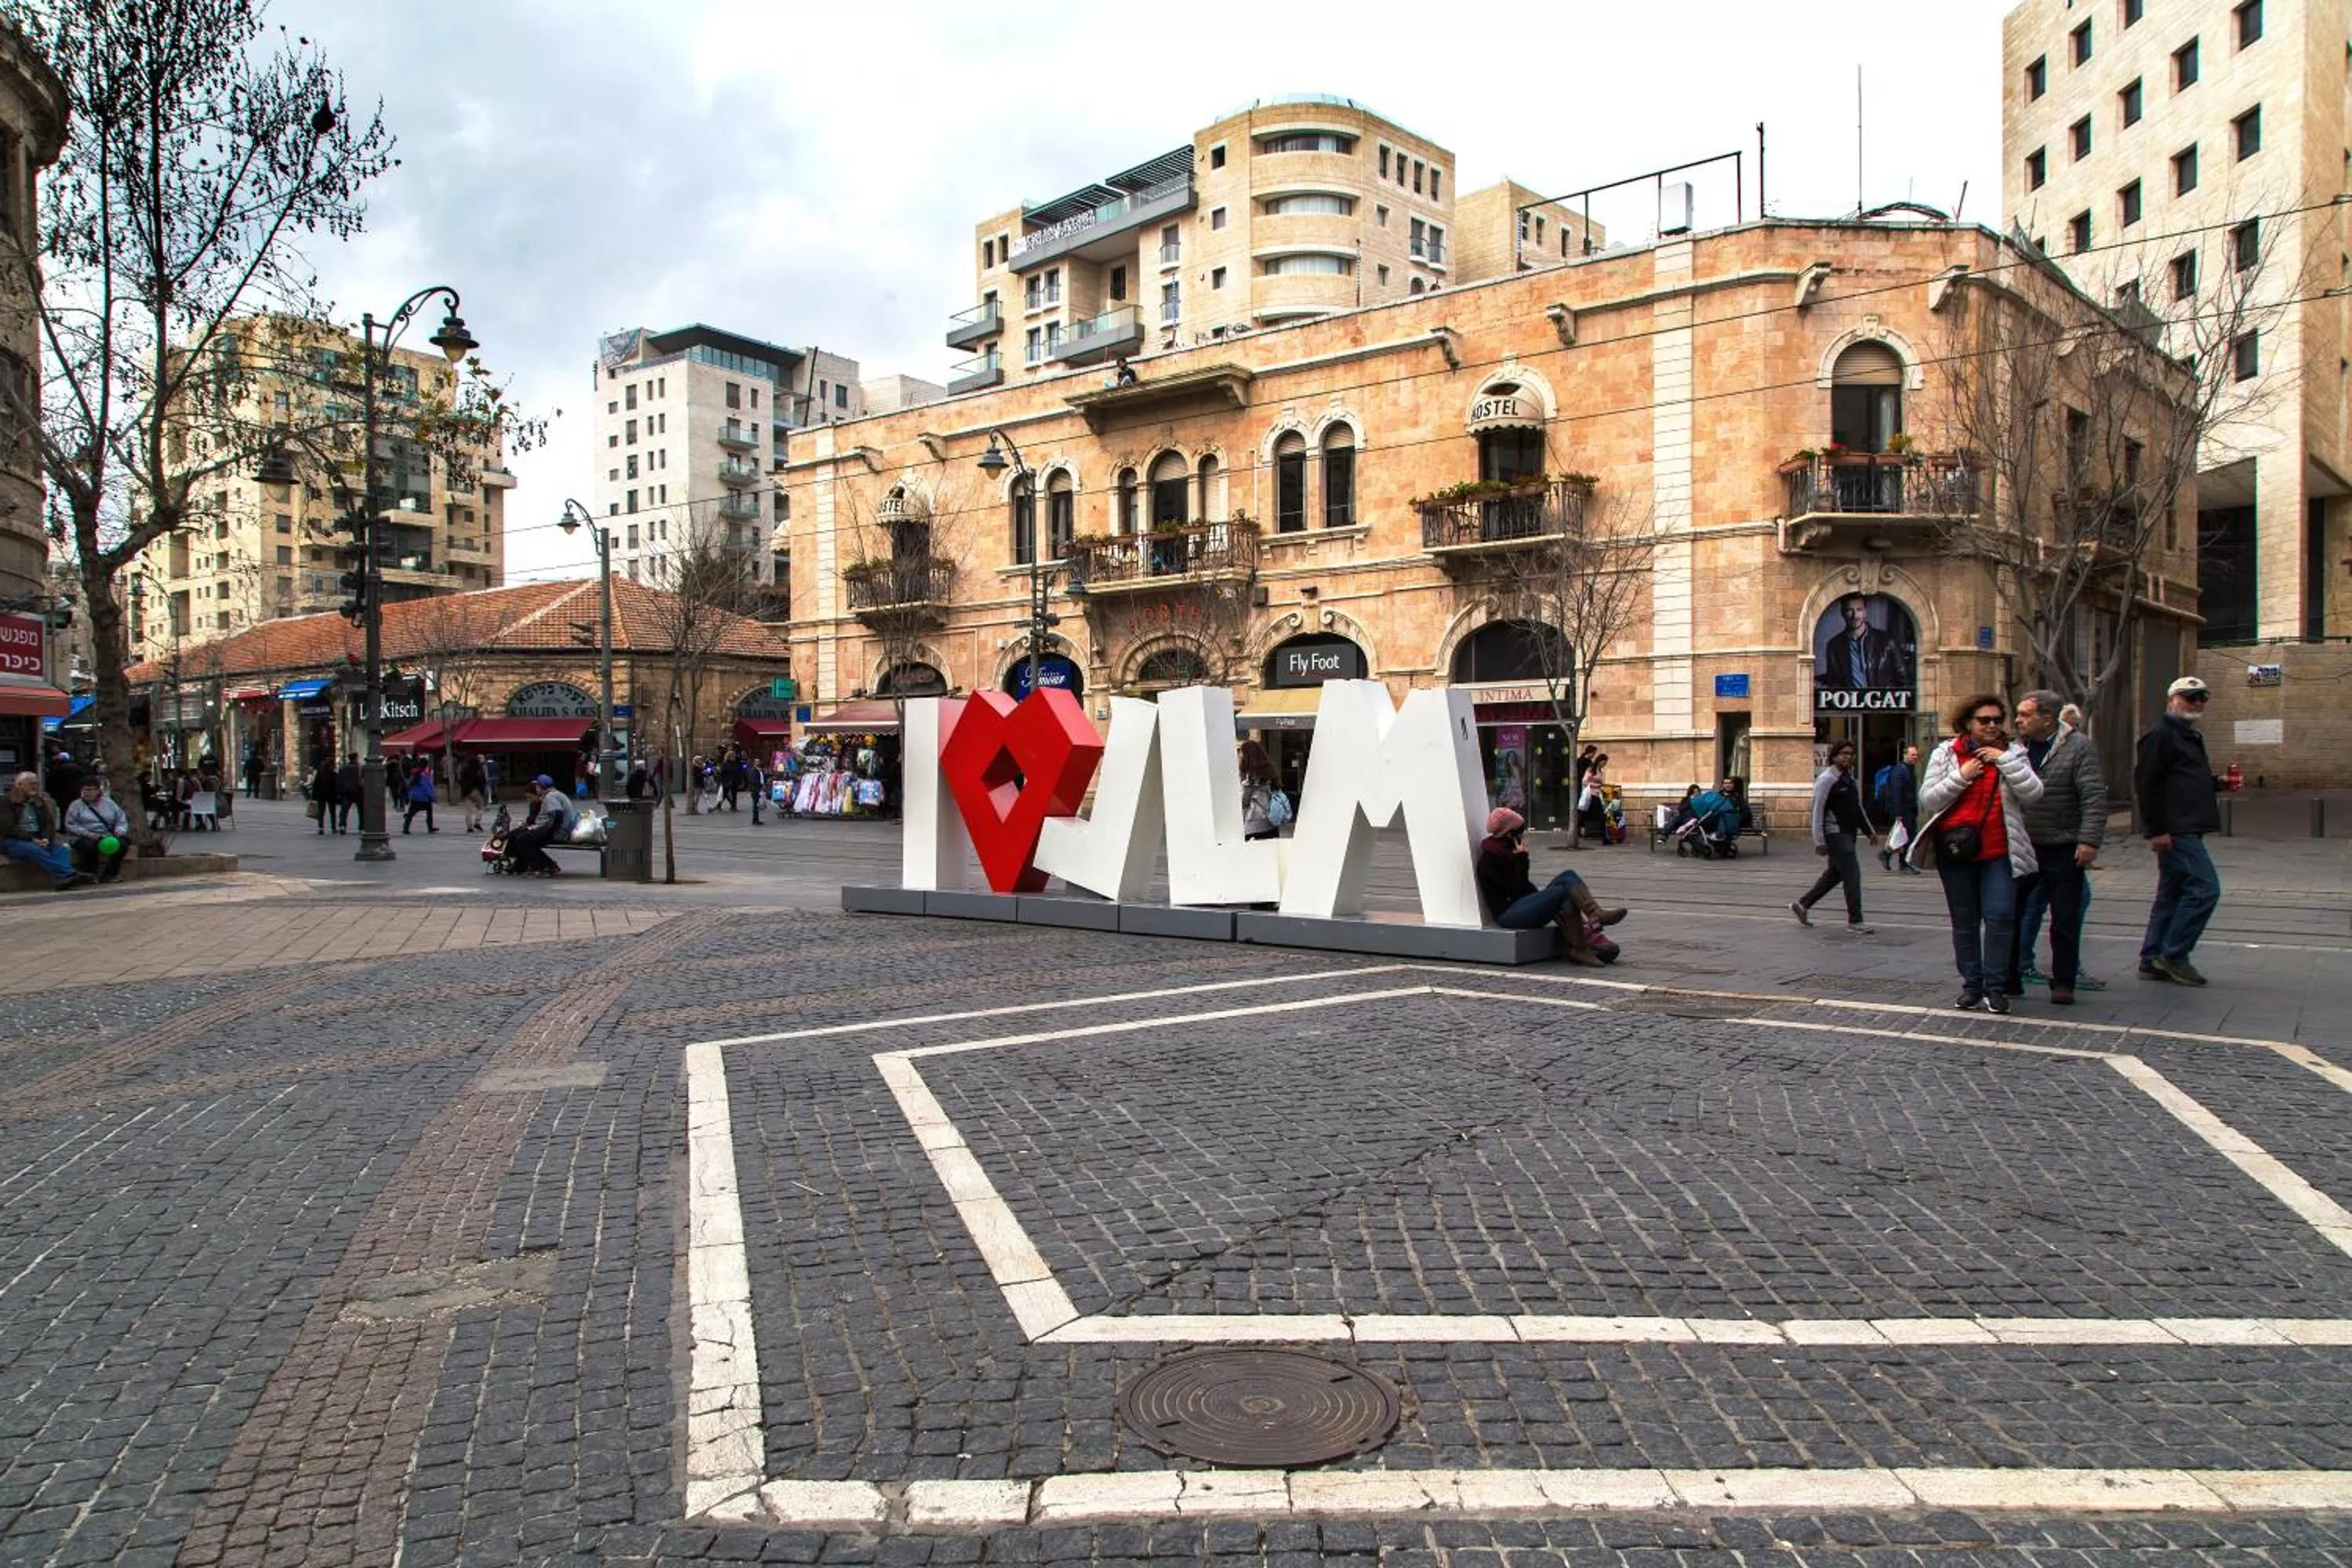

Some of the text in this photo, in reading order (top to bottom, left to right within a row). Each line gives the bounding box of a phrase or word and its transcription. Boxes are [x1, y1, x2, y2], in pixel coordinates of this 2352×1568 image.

[1290, 653, 1339, 676] Fly Foot
[1479, 690, 1533, 702] INTIMA
[1819, 691, 1911, 709] POLGAT
[562, 707, 596, 717] SOES
